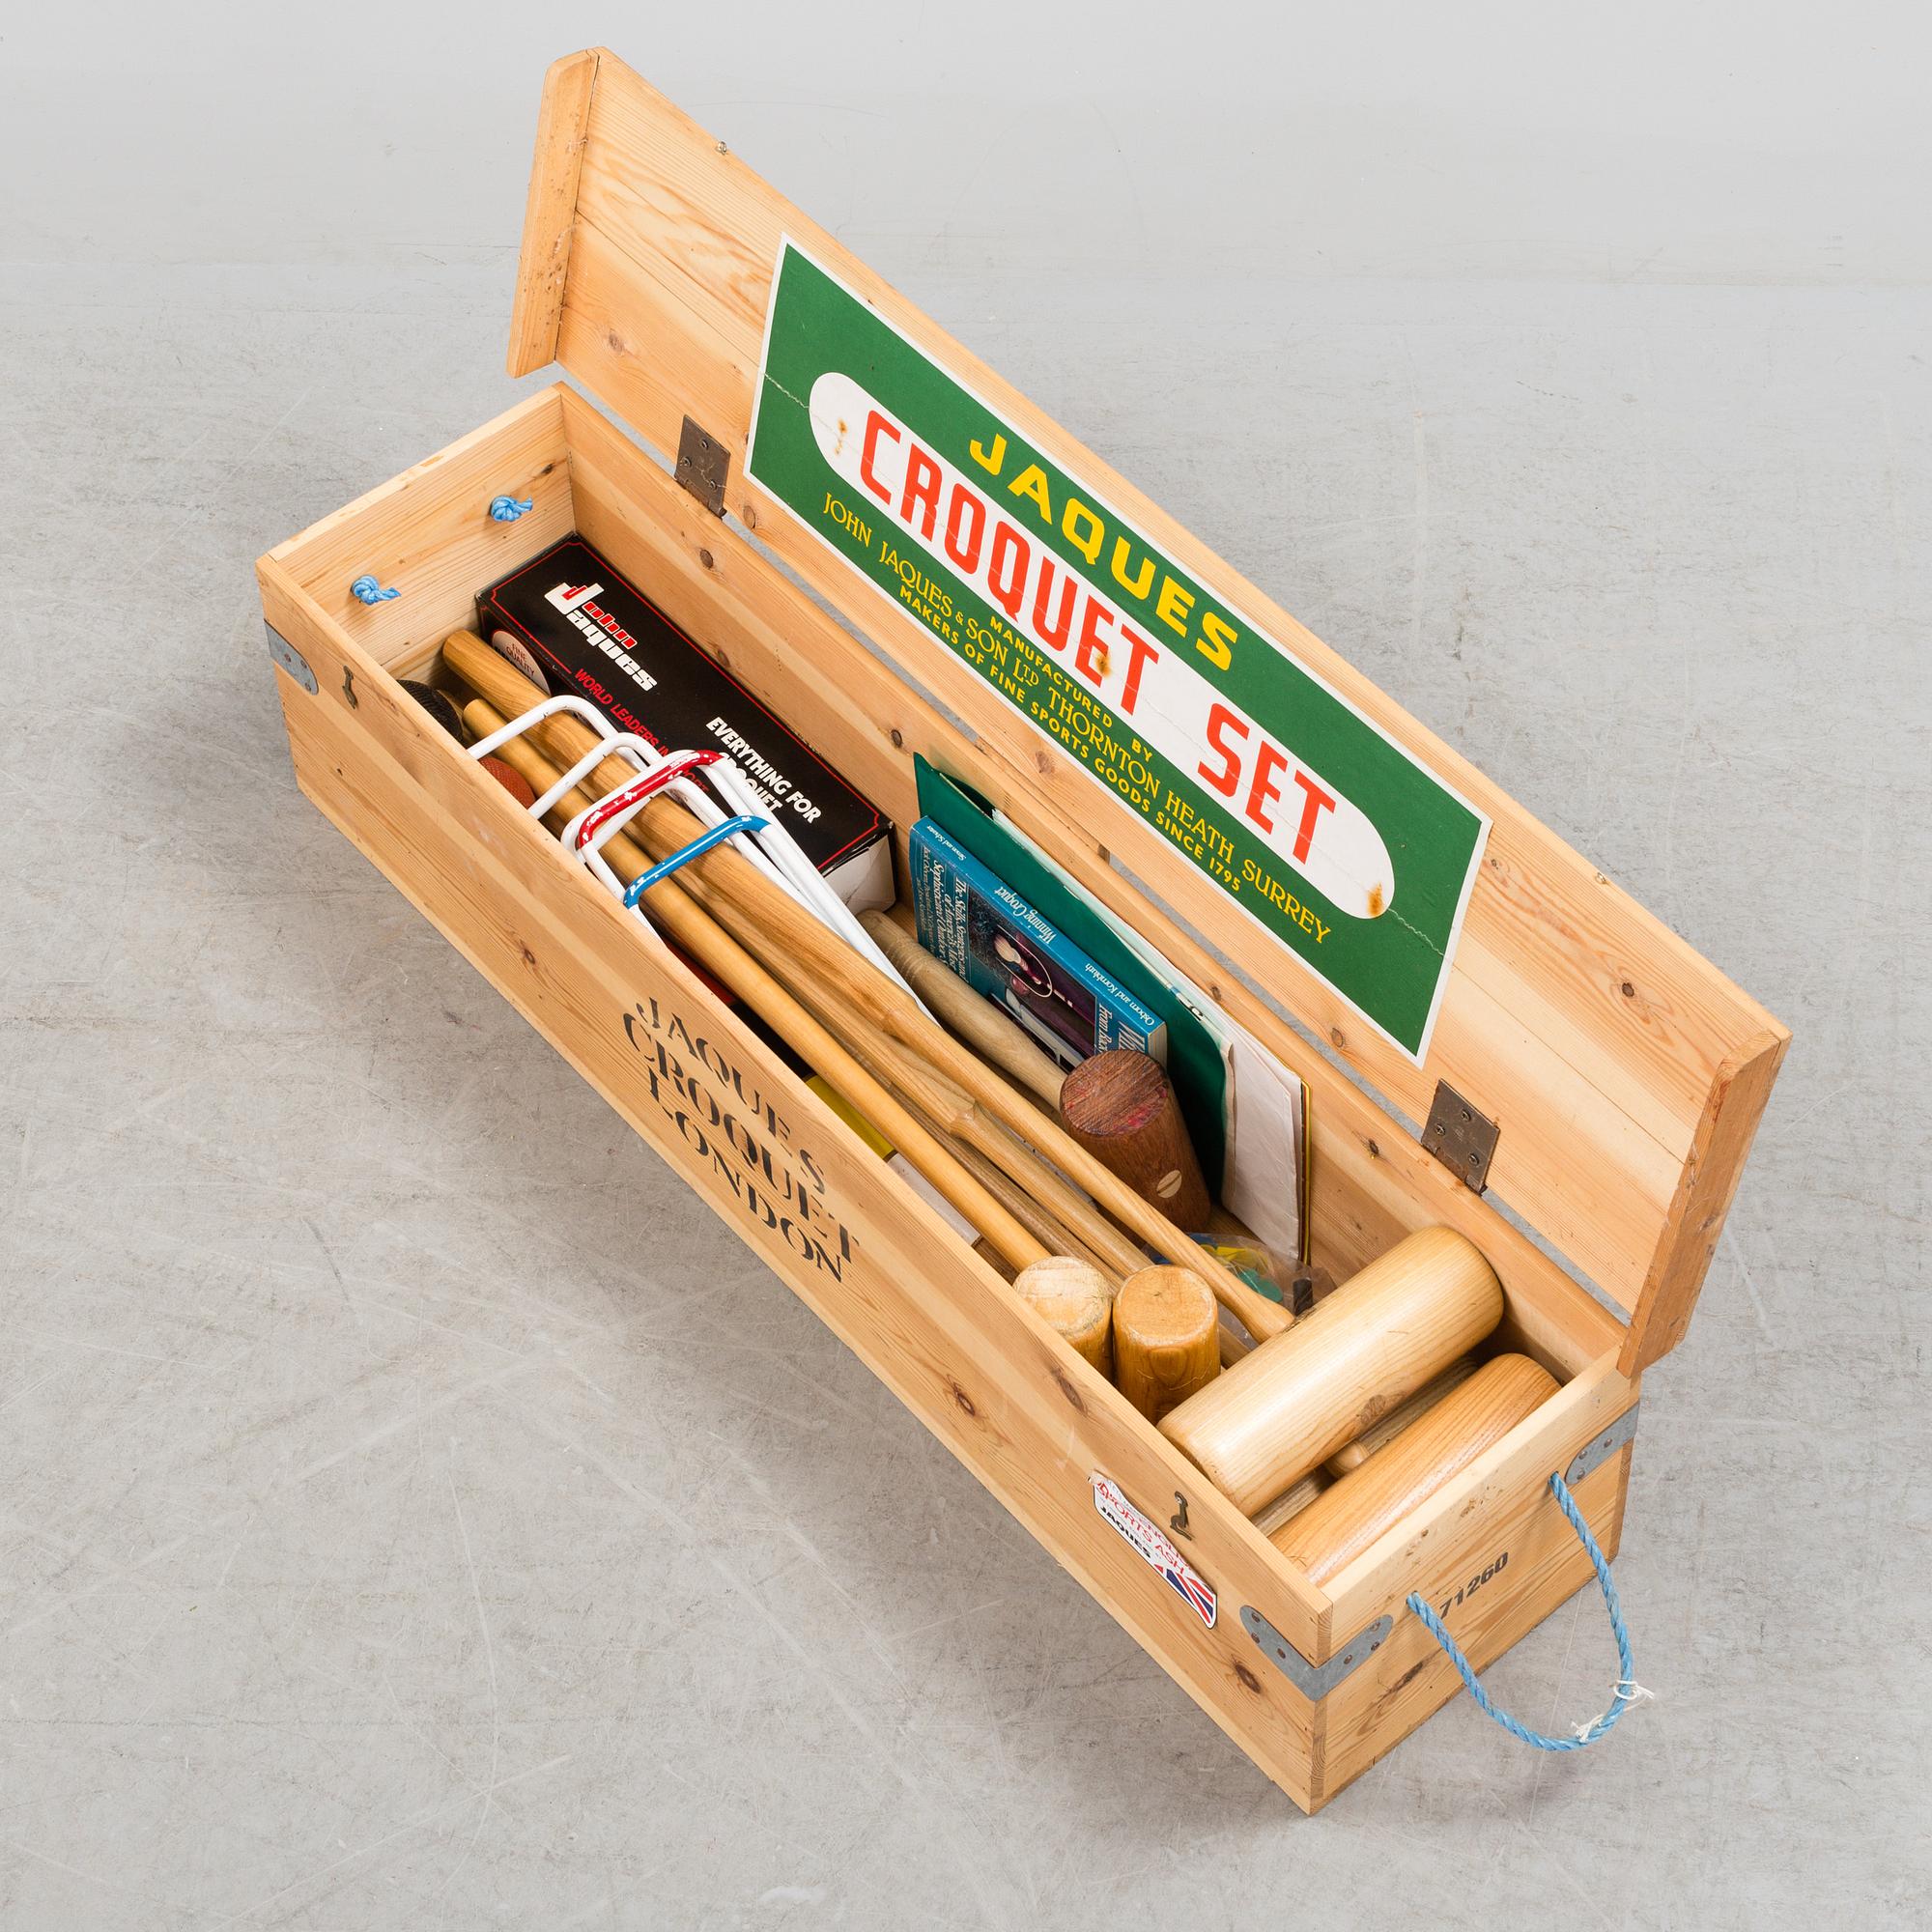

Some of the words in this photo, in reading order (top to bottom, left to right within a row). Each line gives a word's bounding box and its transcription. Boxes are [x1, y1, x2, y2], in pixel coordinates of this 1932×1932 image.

[969, 433, 1238, 671] JAQUES
[860, 410, 1159, 716] CROQUET
[1198, 703, 1336, 865] SET
[574, 668, 613, 705] WORLD
[611, 703, 659, 751] LEADERS
[823, 492, 872, 548] JOHN
[879, 541, 952, 617] JAQUES
[955, 611, 964, 626] &
[966, 617, 1009, 667] SON
[1048, 687, 1160, 799] THORNTON
[1165, 790, 1236, 864] HEATH
[1241, 859, 1331, 944] SURREY
[990, 615, 1113, 727] MANUFACTURED
[1132, 738, 1152, 762] BY
[706, 717, 792, 795] EVERYTHING
[785, 791, 822, 824] FOR
[899, 584, 959, 645] MAKERS
[965, 643, 985, 666] OF
[990, 665, 1026, 704] FINE
[1031, 701, 1090, 758] SPORTS
[1094, 758, 1151, 812] GOODS
[1155, 811, 1205, 859] SINCE
[1209, 857, 1241, 892] 1795
[955, 876, 966, 897] The
[994, 886, 1027, 917] Croquet
[1023, 909, 1057, 944] Winning
[1085, 963, 1118, 993] Kornbluth
[1099, 1003, 1113, 1032] From
[1115, 990, 1130, 1004] and
[1129, 1001, 1154, 1025] Osborn
[623, 1012, 860, 1264] CROQUET
[636, 997, 826, 1194] JAQUES
[648, 1066, 842, 1283] LONDON
[1100, 1506, 1151, 1558] JAQUES
